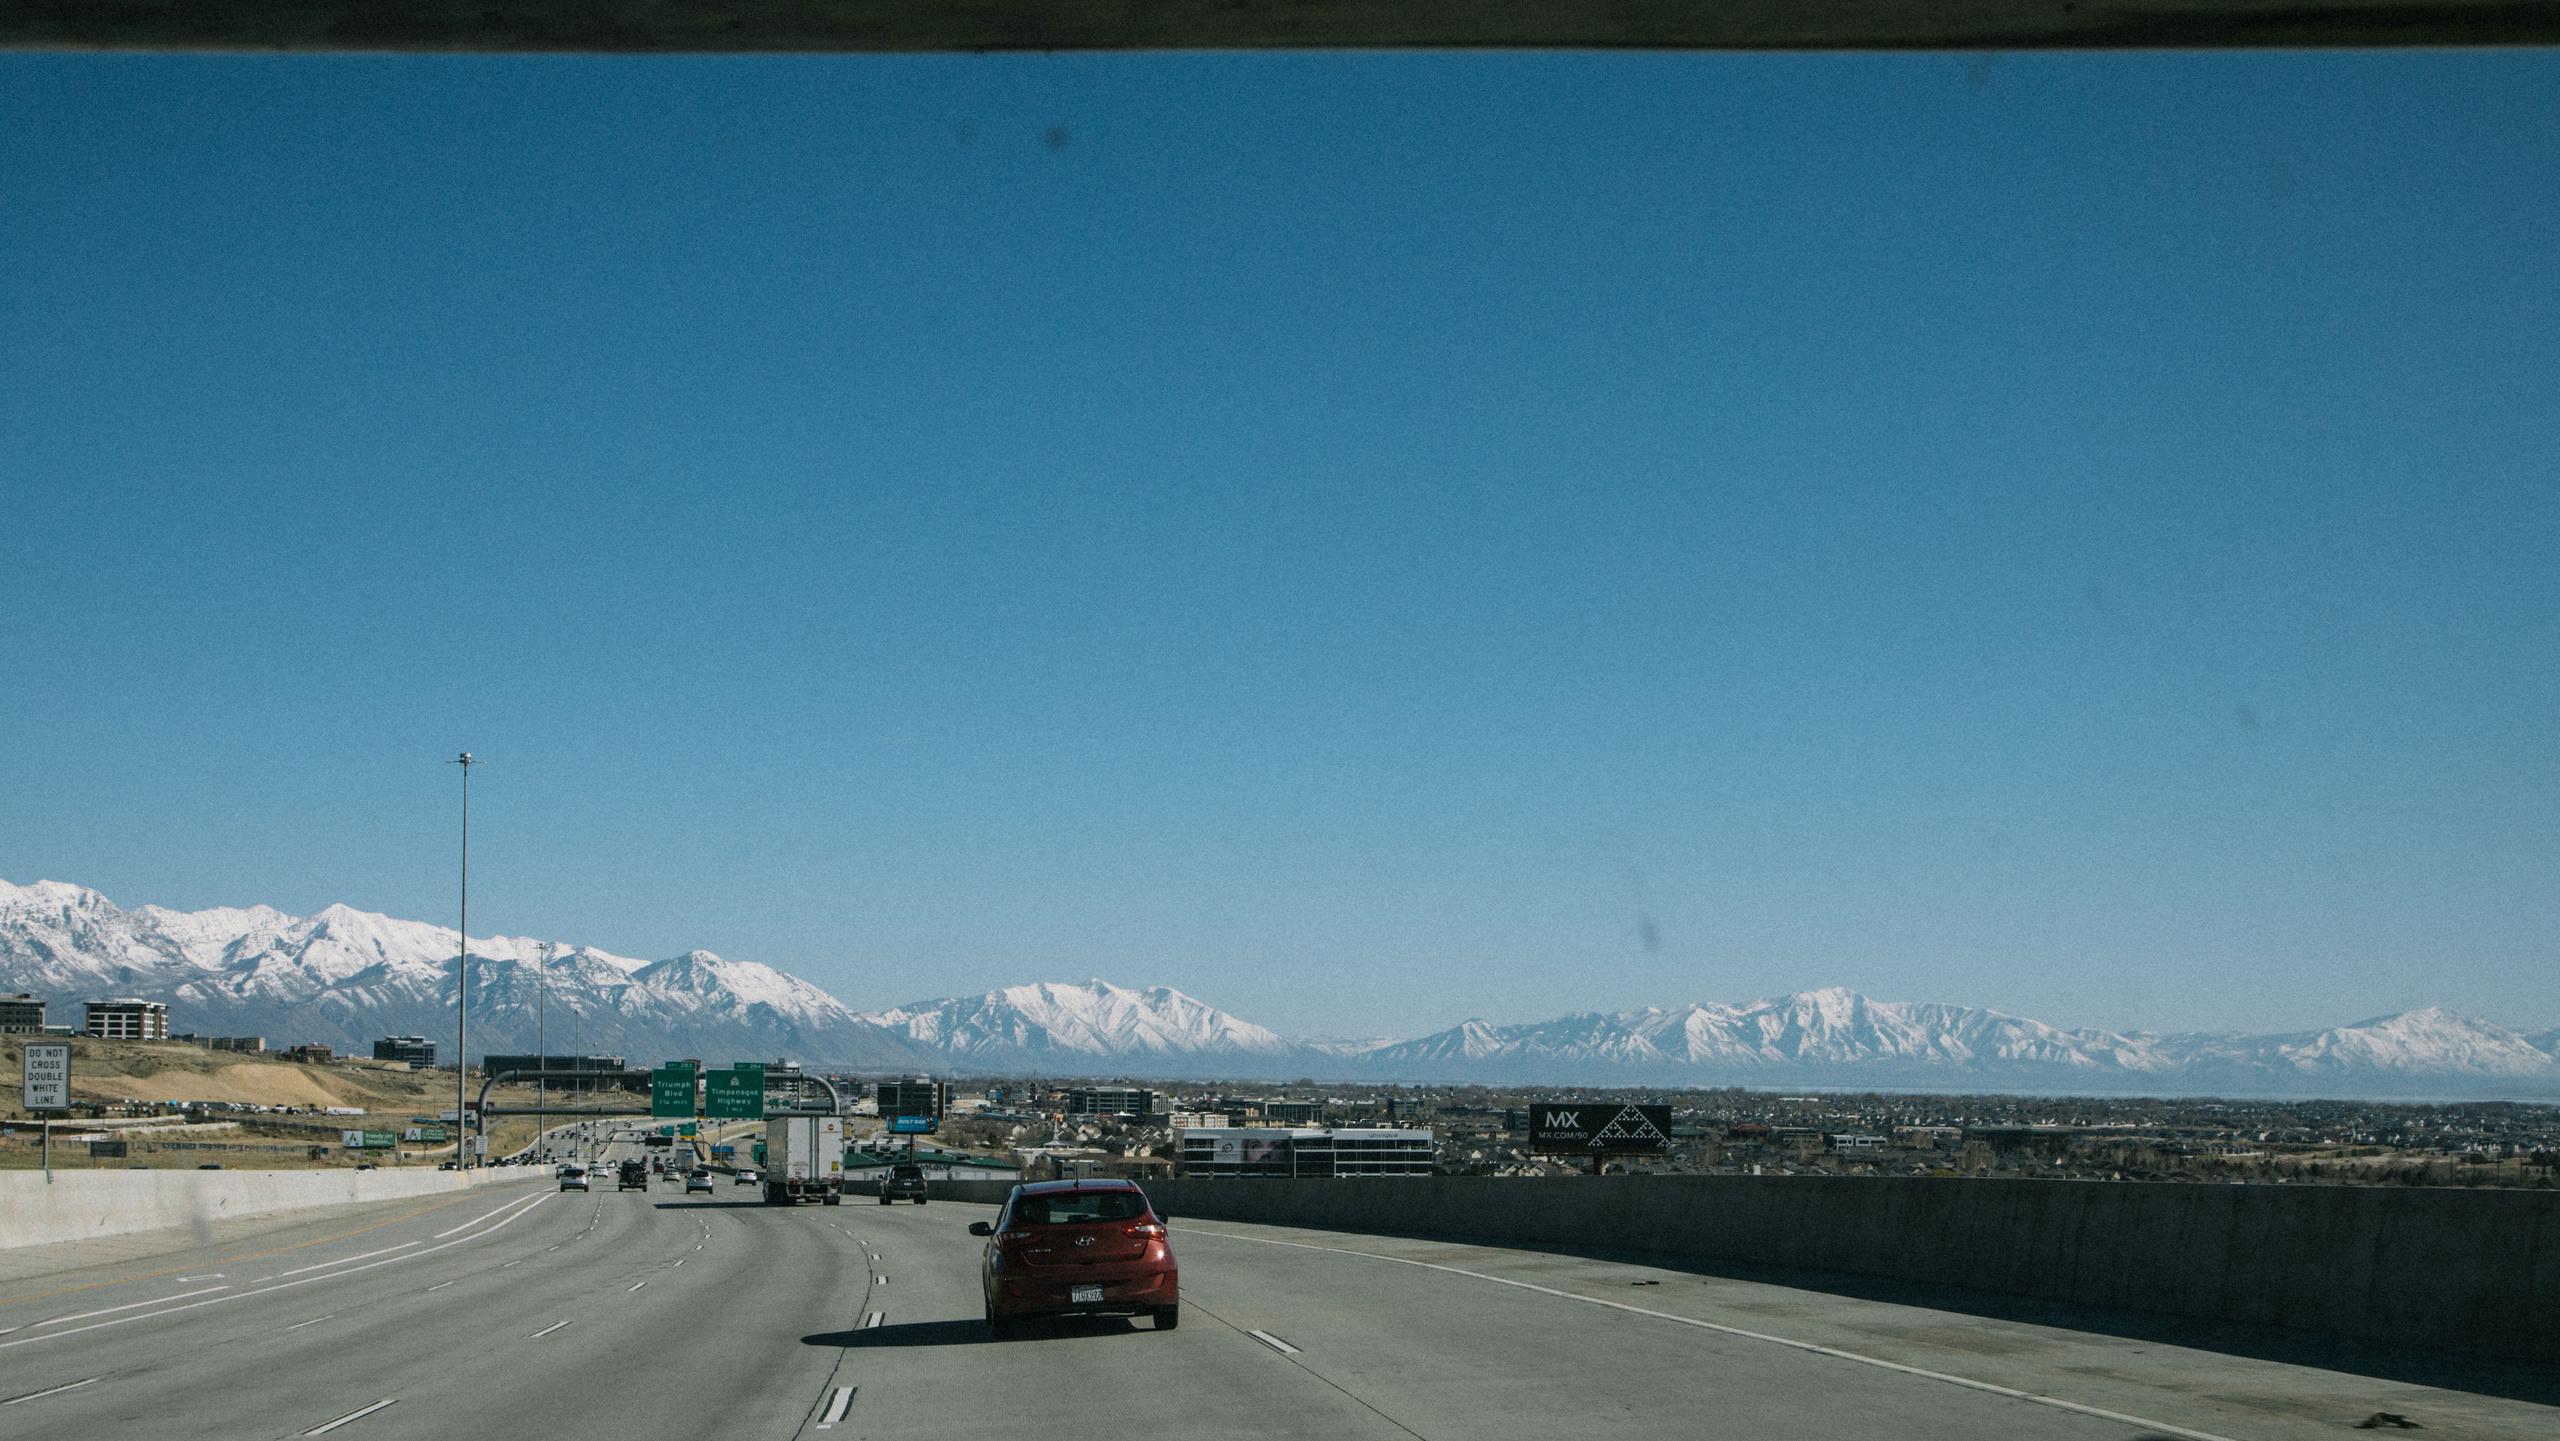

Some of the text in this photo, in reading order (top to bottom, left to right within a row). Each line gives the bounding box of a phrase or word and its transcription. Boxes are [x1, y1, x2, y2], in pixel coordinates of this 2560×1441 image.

[30, 1049, 62, 1058] DO NOT
[32, 1060, 60, 1069] CROSS
[28, 1072, 62, 1080] DOUBLE
[32, 1084, 58, 1092] WHITE
[712, 1089, 758, 1097] Timpanogos
[36, 1096, 54, 1104] LINE
[1545, 1111, 1580, 1128] MX
